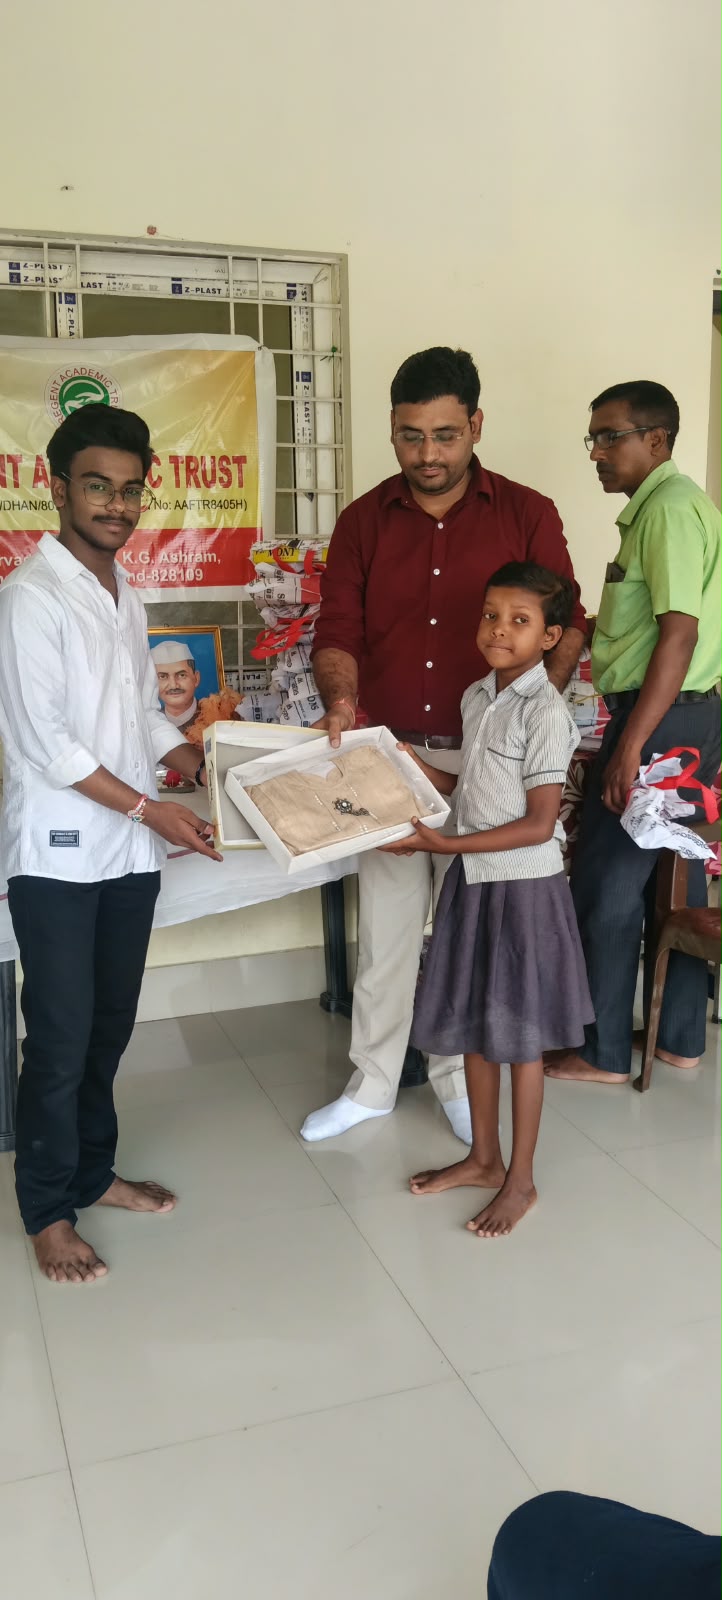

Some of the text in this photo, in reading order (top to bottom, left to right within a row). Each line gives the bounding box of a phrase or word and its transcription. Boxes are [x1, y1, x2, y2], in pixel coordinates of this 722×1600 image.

[79, 281, 104, 289] LAST
[184, 286, 222, 295] Z-PLAST
[67, 307, 75, 337] Z-PLA
[49, 367, 119, 424] REGENT ACADEMIC TR
[169, 455, 247, 488] TRUST
[174, 499, 248, 511] AAFTR8405H)
[122, 551, 155, 564] K.G.
[160, 550, 221, 564] Ashram,
[126, 568, 204, 582] nd-828109
